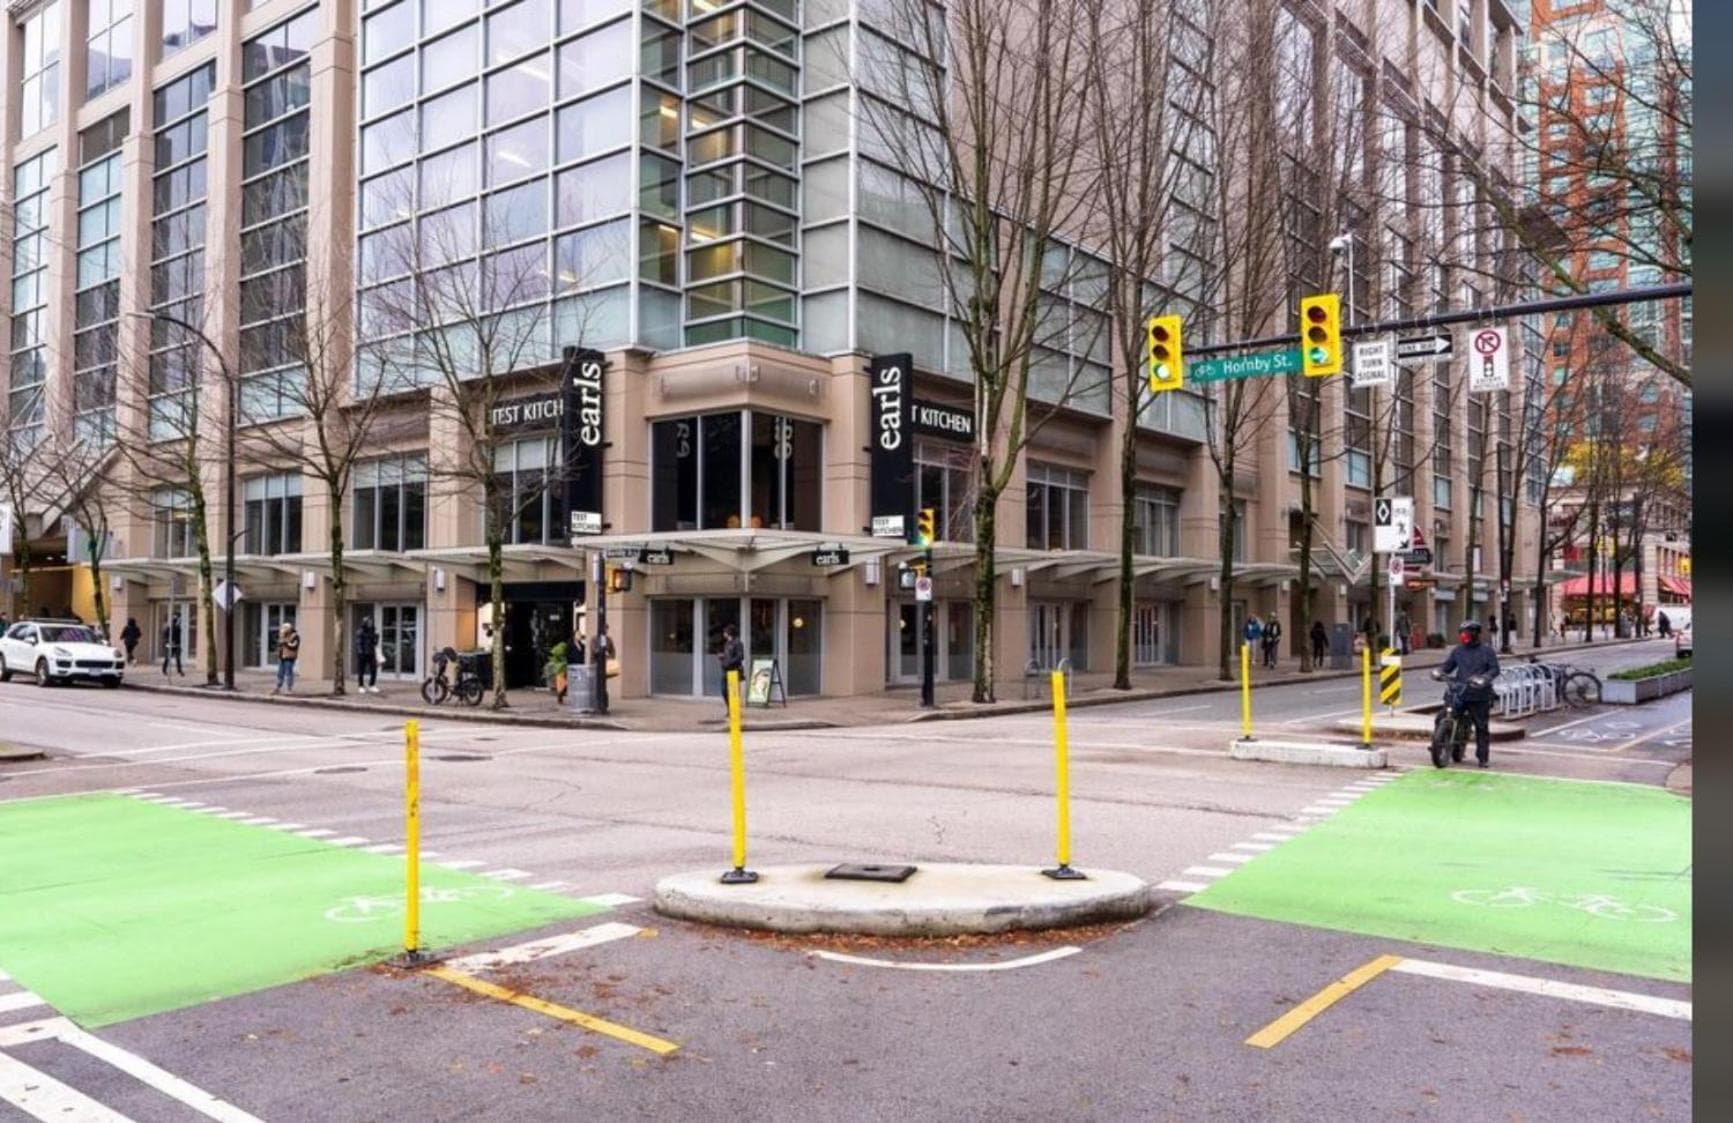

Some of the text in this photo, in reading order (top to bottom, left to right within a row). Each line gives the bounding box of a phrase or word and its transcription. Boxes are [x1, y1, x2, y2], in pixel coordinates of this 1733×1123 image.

[1359, 344, 1385, 356] RIGHT
[1223, 358, 1271, 375] Hornby
[1362, 359, 1384, 368] TURN
[1358, 370, 1386, 381] SIGNAL
[573, 362, 601, 446] earls
[872, 366, 901, 450] earls
[492, 398, 564, 425] TEST KITCH
[920, 406, 971, 433] KITCHEN
[573, 512, 588, 521] TEST
[646, 552, 670, 564] earls
[816, 551, 840, 565] earls
